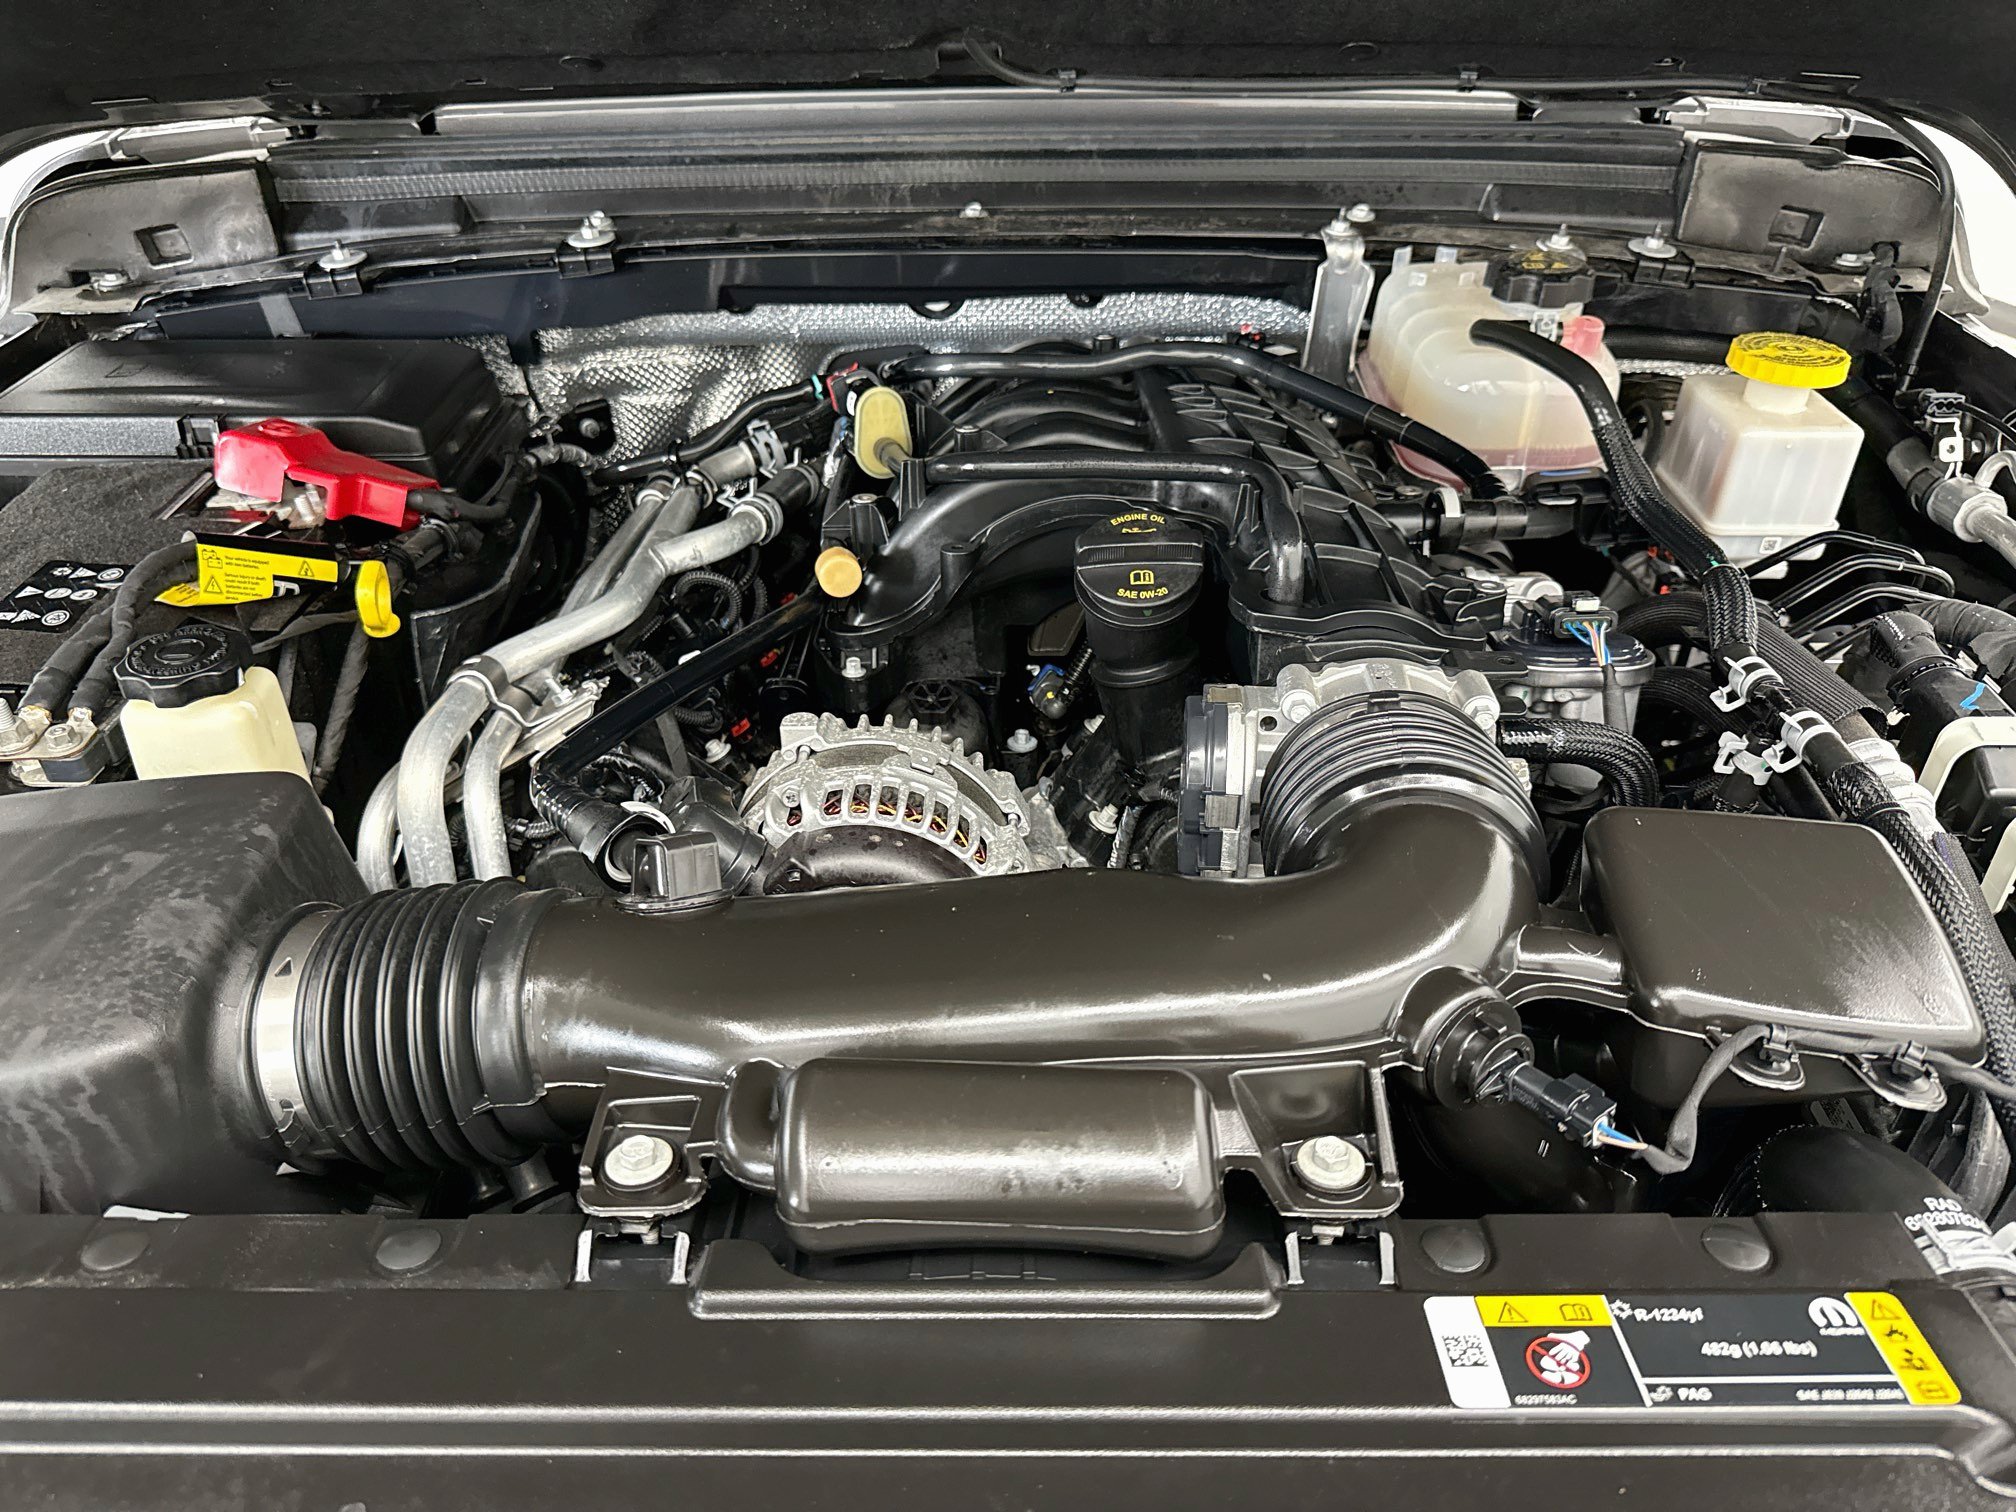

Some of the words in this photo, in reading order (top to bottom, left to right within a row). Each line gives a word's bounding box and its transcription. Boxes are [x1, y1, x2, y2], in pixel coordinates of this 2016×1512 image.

[1110, 513, 1148, 526] ENGINE
[1150, 513, 1166, 525] OIL
[1117, 588, 1138, 599] SAE
[1139, 587, 1169, 599] 0W-20
[1923, 1197, 1963, 1212] RAD
[1677, 1386, 1713, 1401] PAG
